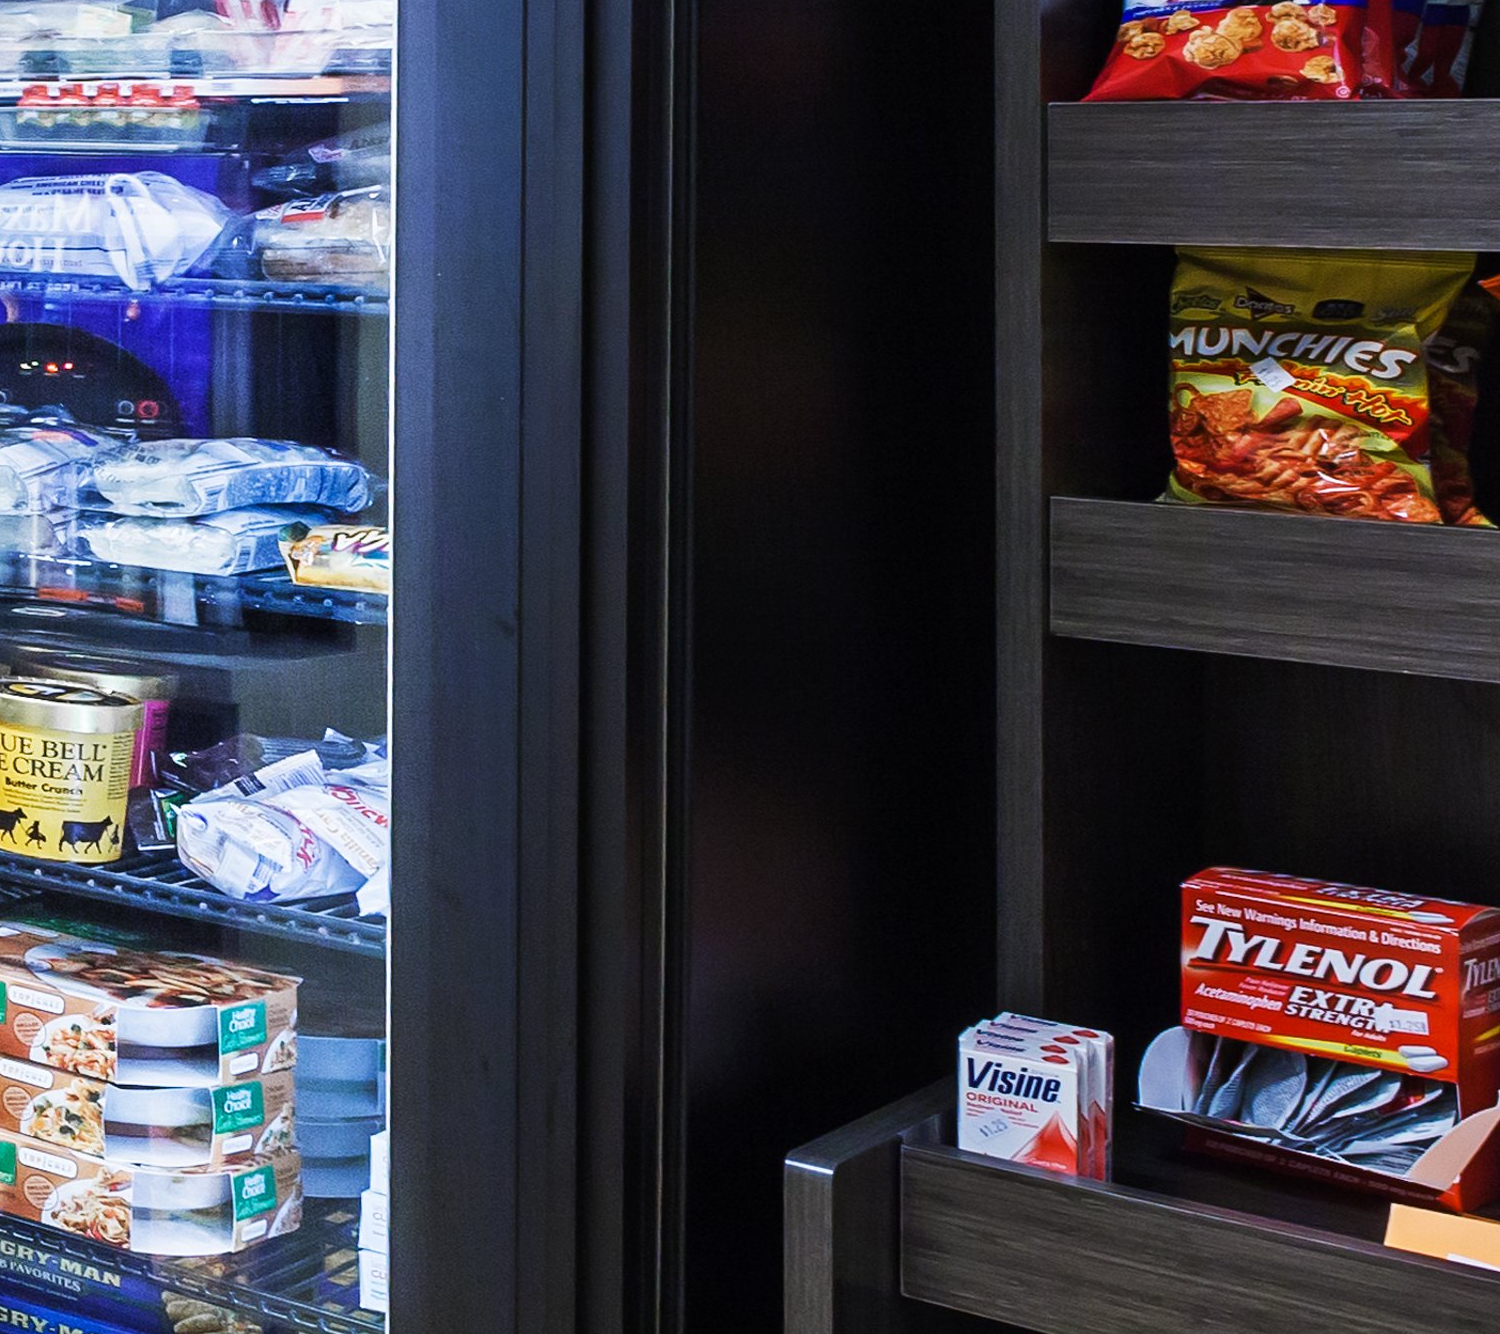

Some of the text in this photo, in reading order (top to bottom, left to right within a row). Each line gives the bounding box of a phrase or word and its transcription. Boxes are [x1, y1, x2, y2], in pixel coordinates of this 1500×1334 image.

[41, 741, 104, 762] BELL
[11, 753, 104, 783] CREAM
[4, 776, 83, 797] Butter Crunch
[1195, 899, 1441, 955] See New Warnings Information & Directions
[1188, 915, 1440, 999] TYLENOL
[1194, 983, 1283, 1013] Acetaminophen
[966, 1057, 1061, 1103] Visine
[966, 1091, 1039, 1114] ORIGINAL
[8, 1262, 81, 1293] FAVORITES
